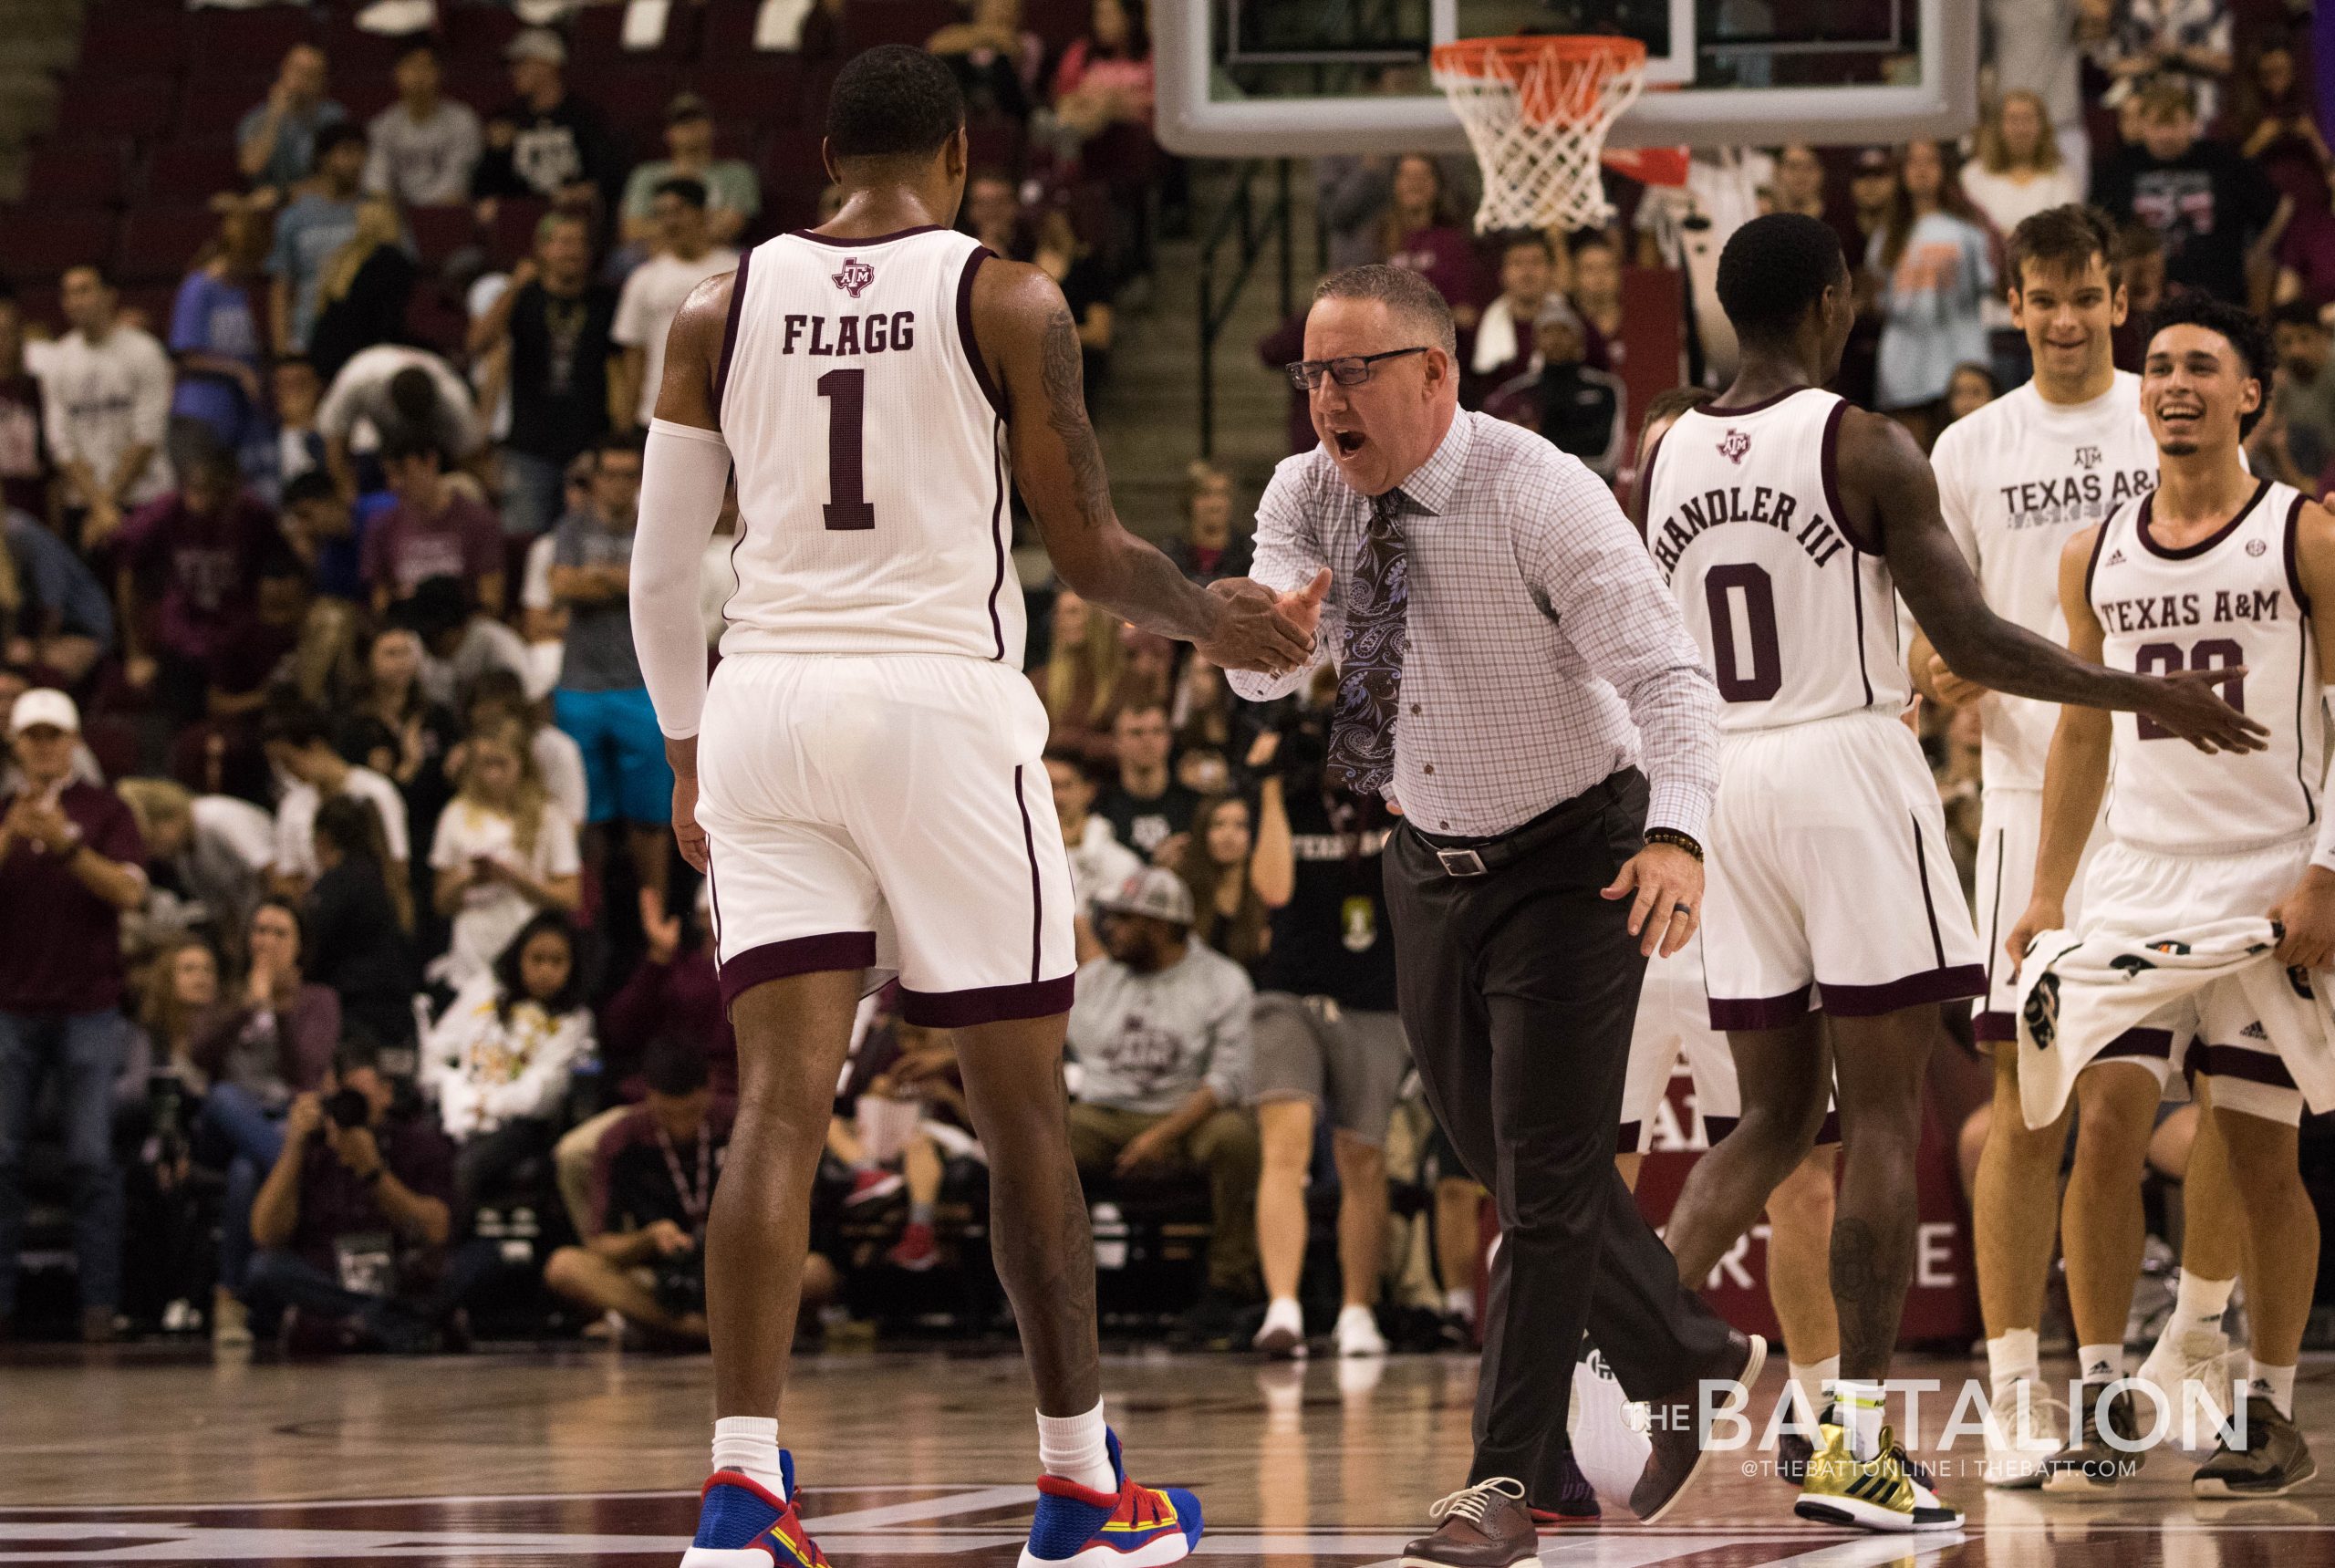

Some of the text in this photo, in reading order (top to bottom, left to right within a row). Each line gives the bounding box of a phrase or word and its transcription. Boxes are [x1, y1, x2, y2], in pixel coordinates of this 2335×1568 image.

[783, 311, 914, 356] FLAGG
[817, 369, 876, 530] 1
[2001, 474, 2102, 514] TEXAS
[1654, 486, 1845, 587] HANDLER III
[1705, 562, 1781, 703] 0
[2101, 589, 2281, 633] TEXAS A&M
